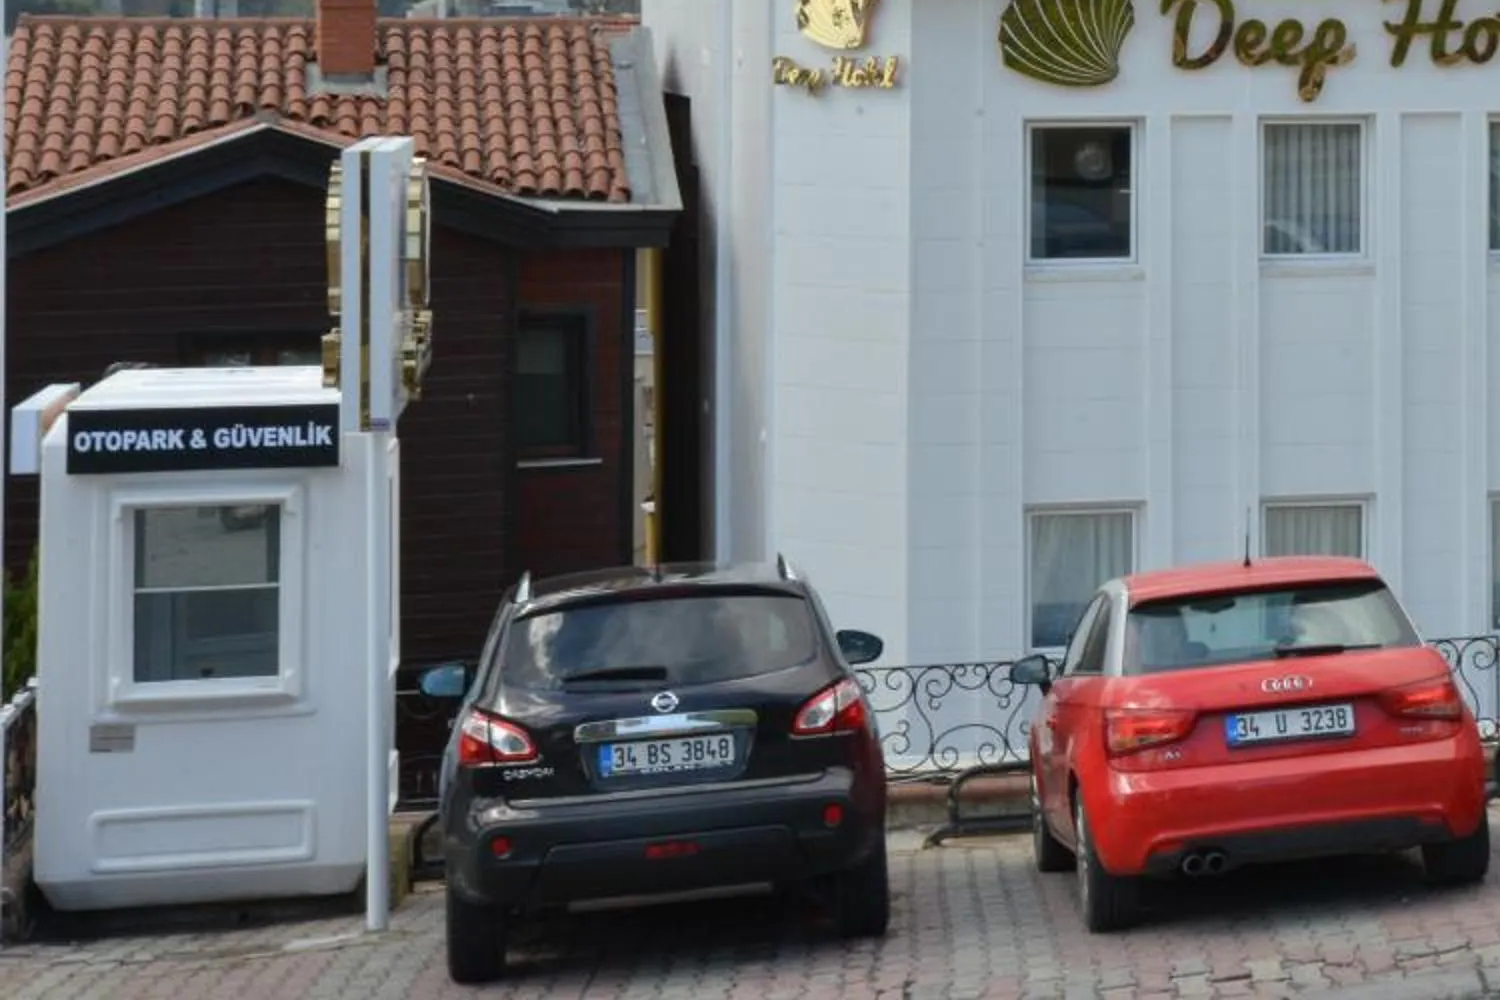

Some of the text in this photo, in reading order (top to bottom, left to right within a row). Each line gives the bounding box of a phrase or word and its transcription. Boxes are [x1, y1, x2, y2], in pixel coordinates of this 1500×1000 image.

[73, 421, 333, 453] OTOPARK & GÜVENLİK
[1237, 706, 1348, 738] 34 U 3238
[614, 745, 637, 769] 34
[646, 742, 671, 765] BS
[680, 737, 730, 762] 3848
